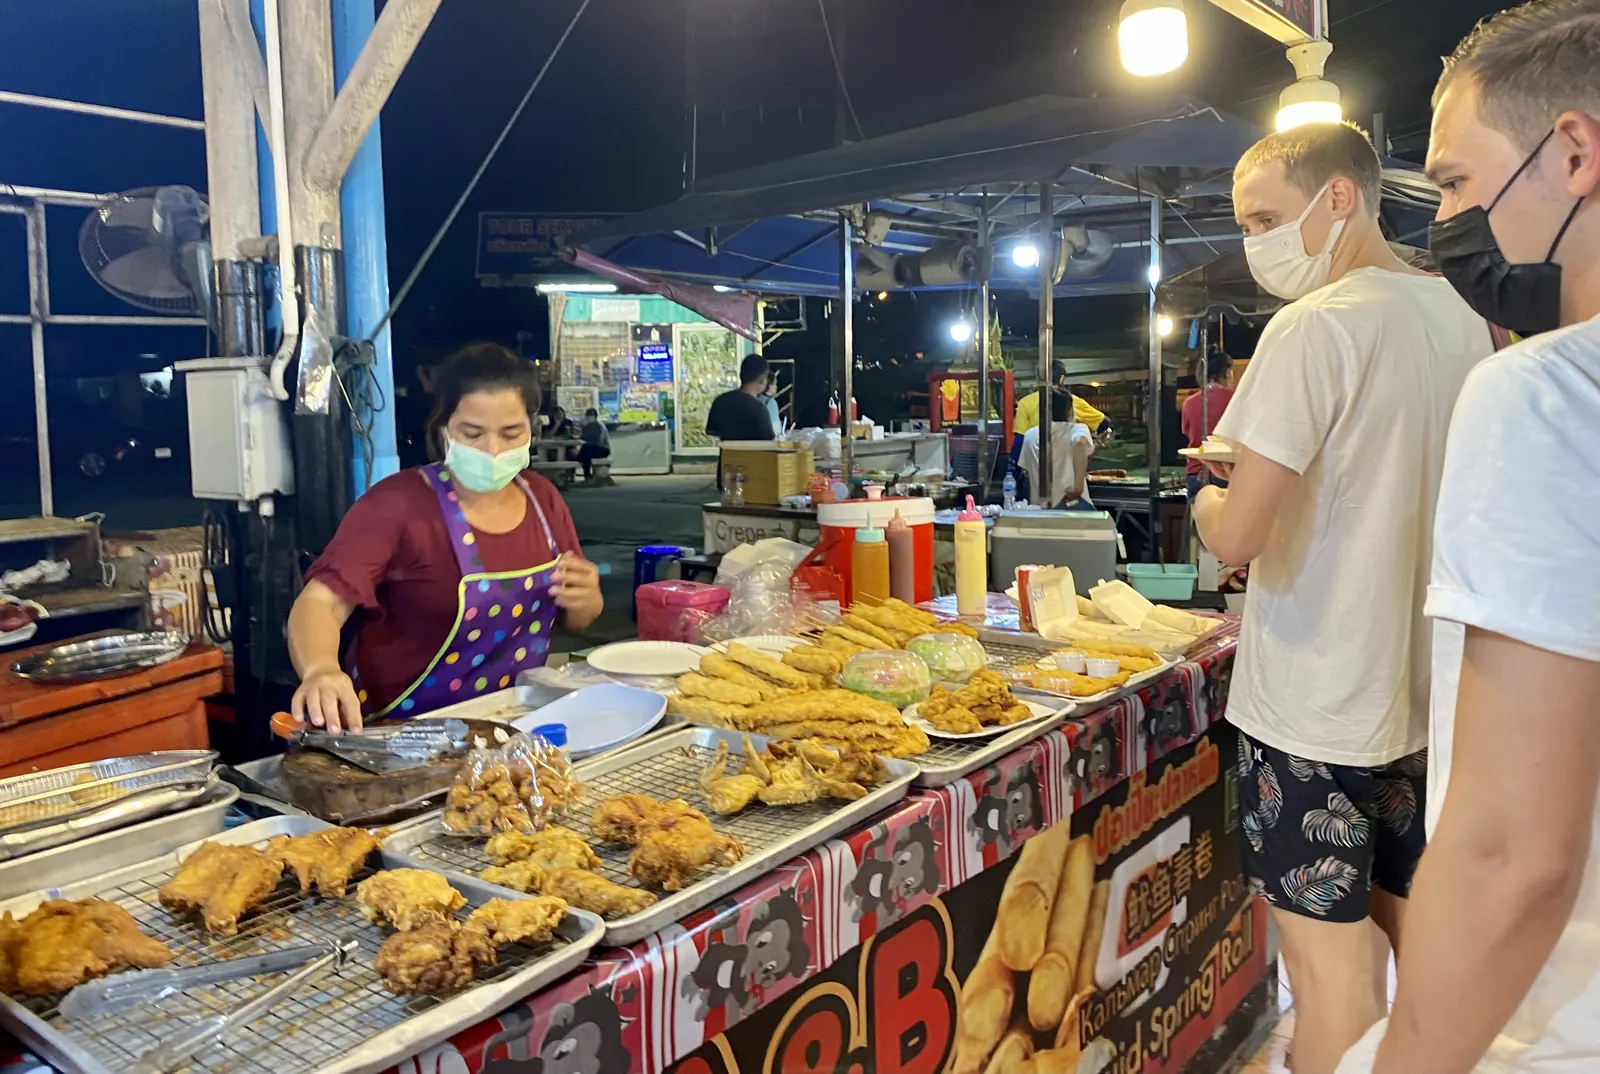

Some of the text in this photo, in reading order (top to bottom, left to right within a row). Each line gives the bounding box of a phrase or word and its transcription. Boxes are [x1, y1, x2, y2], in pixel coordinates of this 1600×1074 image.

[715, 519, 767, 545] Crepe
[1151, 964, 1214, 1058] Spring
[1221, 907, 1252, 980] Roll
